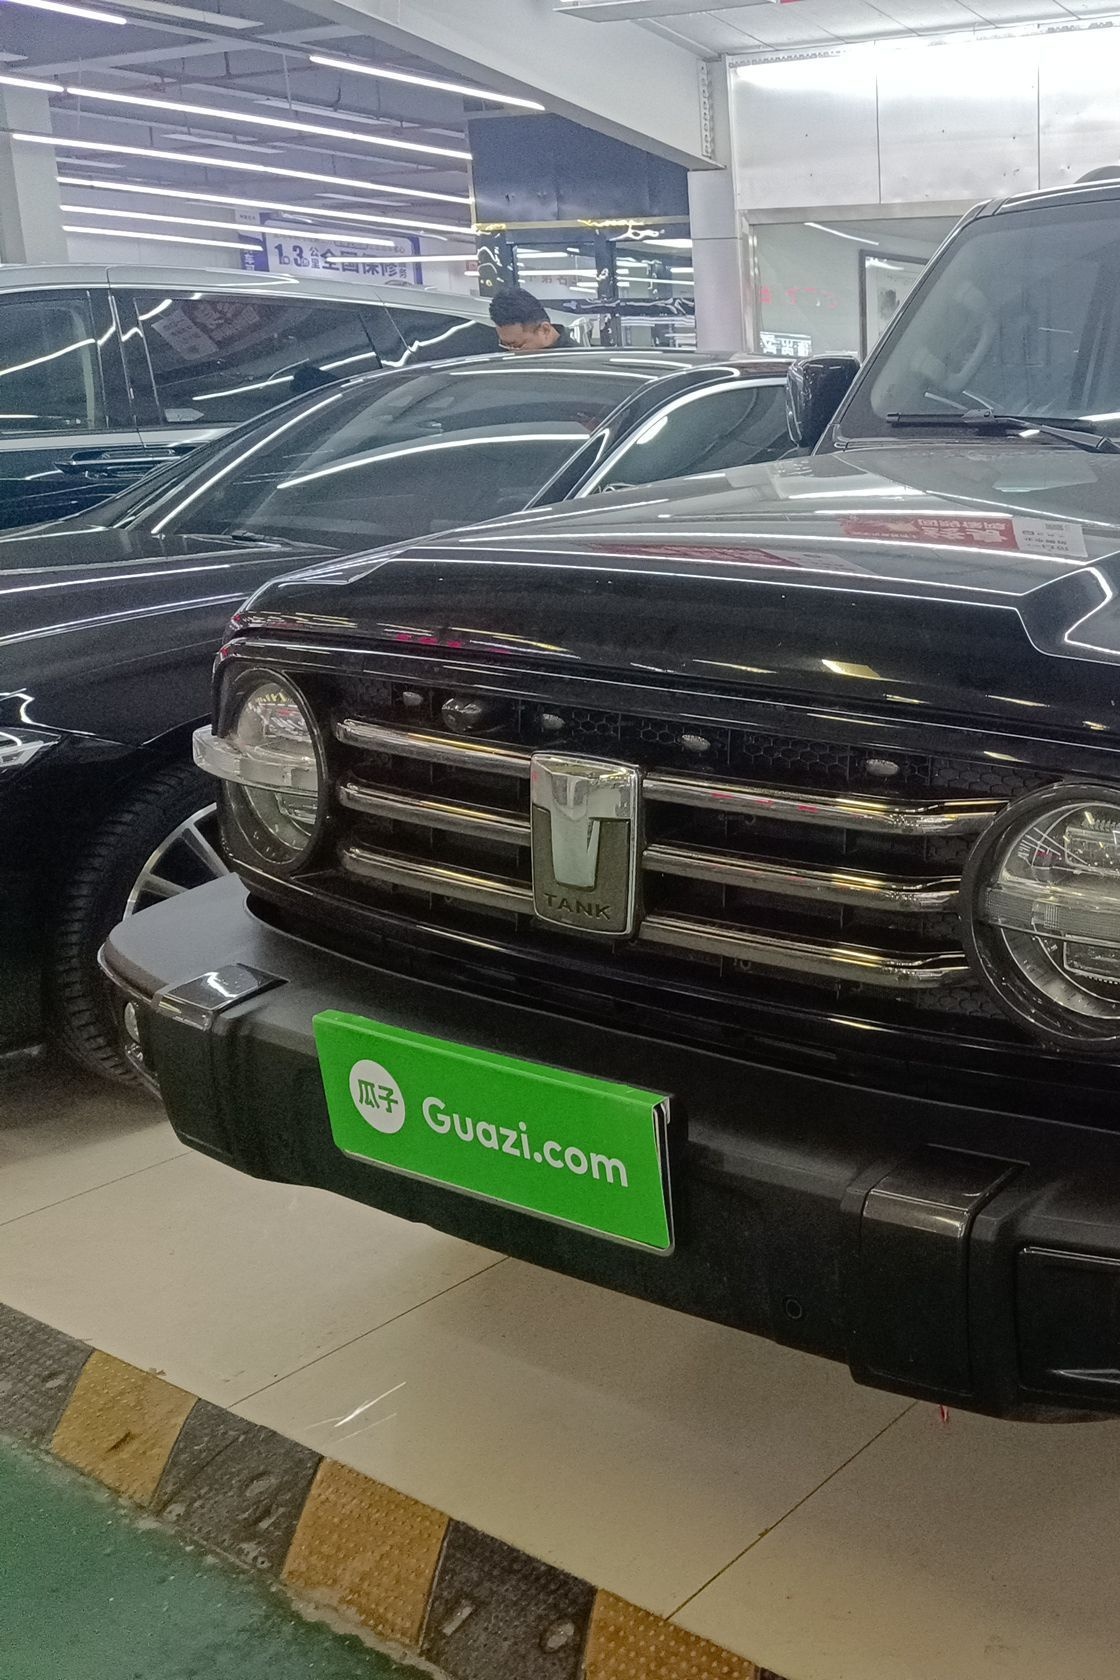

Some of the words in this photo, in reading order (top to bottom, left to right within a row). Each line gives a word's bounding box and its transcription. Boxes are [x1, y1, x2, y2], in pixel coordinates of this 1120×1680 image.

[544, 893, 611, 920] TANK
[358, 1078, 398, 1113] 瓜子
[422, 1096, 629, 1187] Guazi.com
